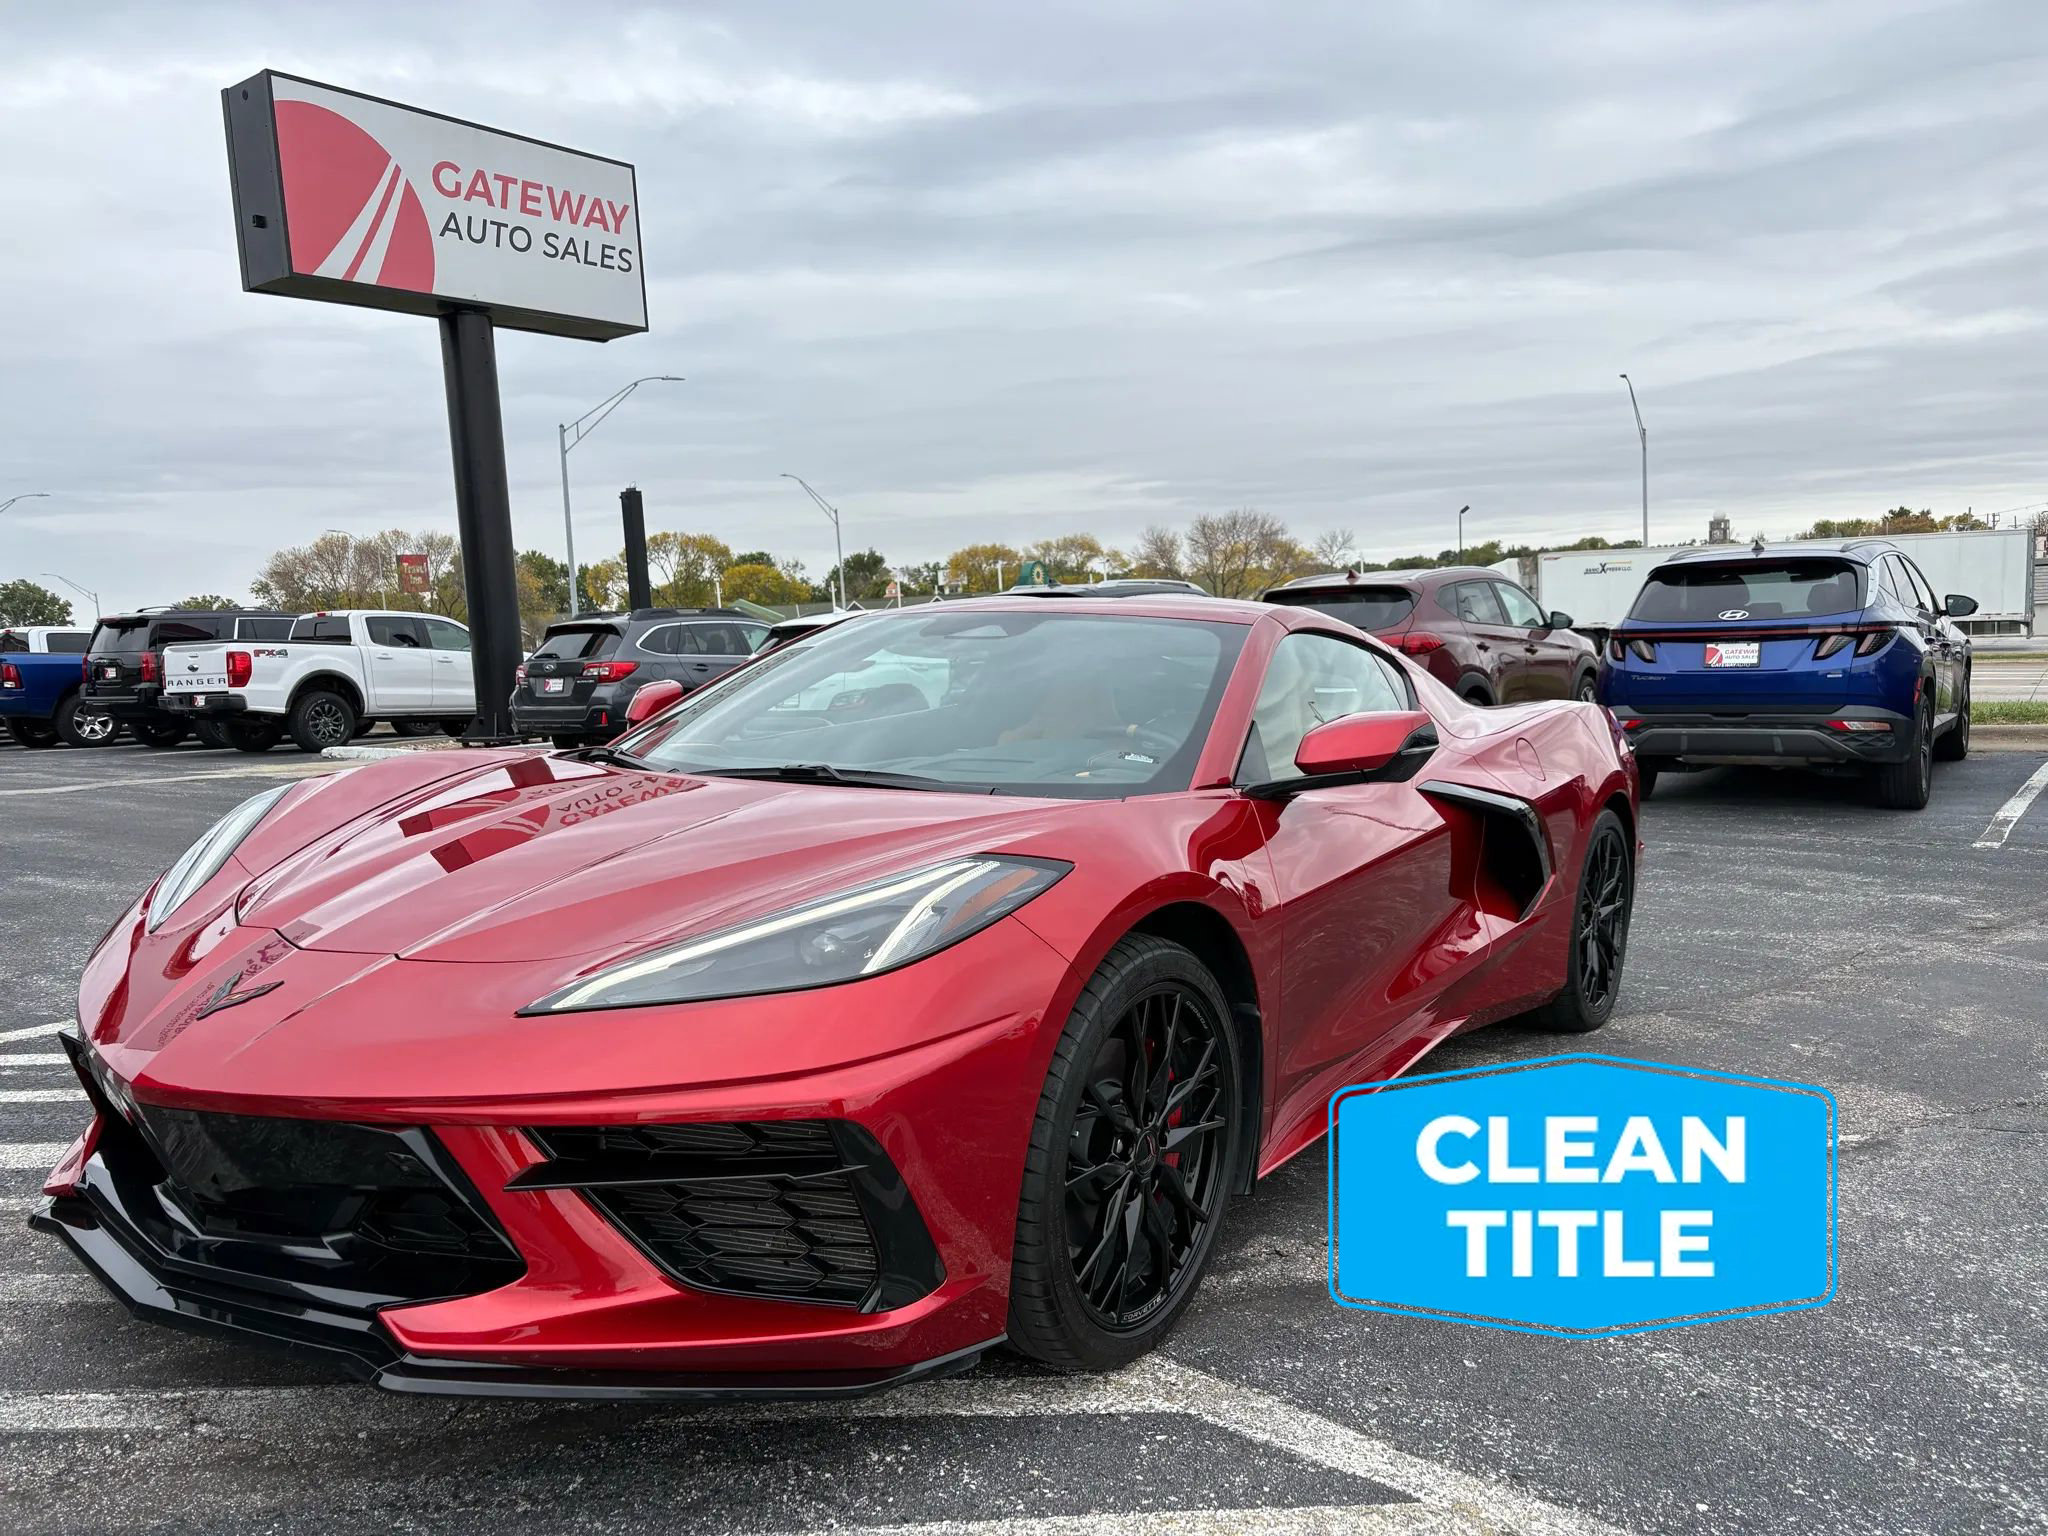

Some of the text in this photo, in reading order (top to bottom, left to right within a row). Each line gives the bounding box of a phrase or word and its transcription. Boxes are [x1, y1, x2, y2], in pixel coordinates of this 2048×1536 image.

[431, 161, 630, 235] GATEWAY
[439, 212, 633, 273] AUTO SALES
[253, 649, 289, 657] FX4
[167, 677, 227, 687] RANGER
[1123, 1294, 1162, 1321] CORVETTE
